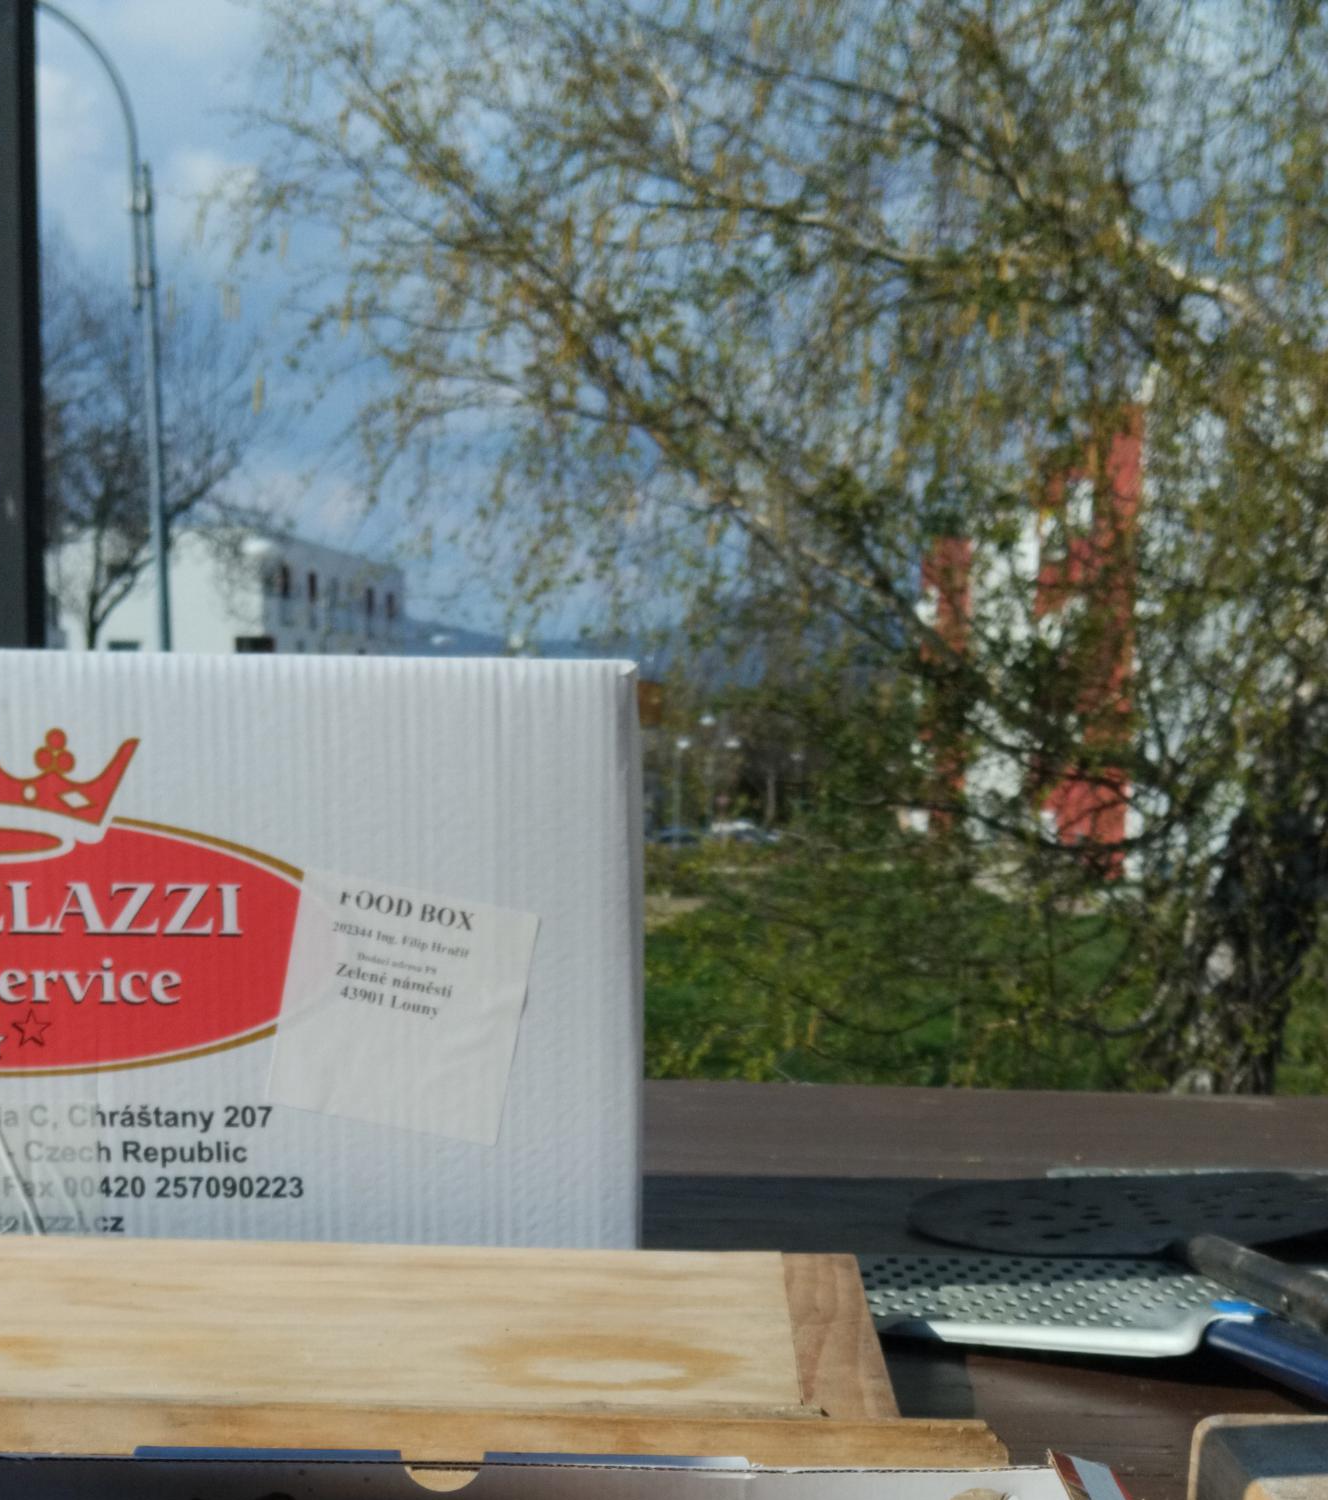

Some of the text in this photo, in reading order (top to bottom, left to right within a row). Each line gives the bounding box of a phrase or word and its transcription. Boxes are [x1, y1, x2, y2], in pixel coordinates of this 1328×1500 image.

[339, 889, 475, 931] FOOD BOX
[336, 961, 454, 999] Zelené náměstí
[340, 985, 440, 1020] 43901 Louny
[67, 1103, 214, 1133] Chráštany
[224, 1106, 273, 1128] 207
[25, 1141, 112, 1163] Czech
[122, 1141, 248, 1168] Republic
[63, 1176, 146, 1199] 00420
[155, 1176, 304, 1199] 257090223
